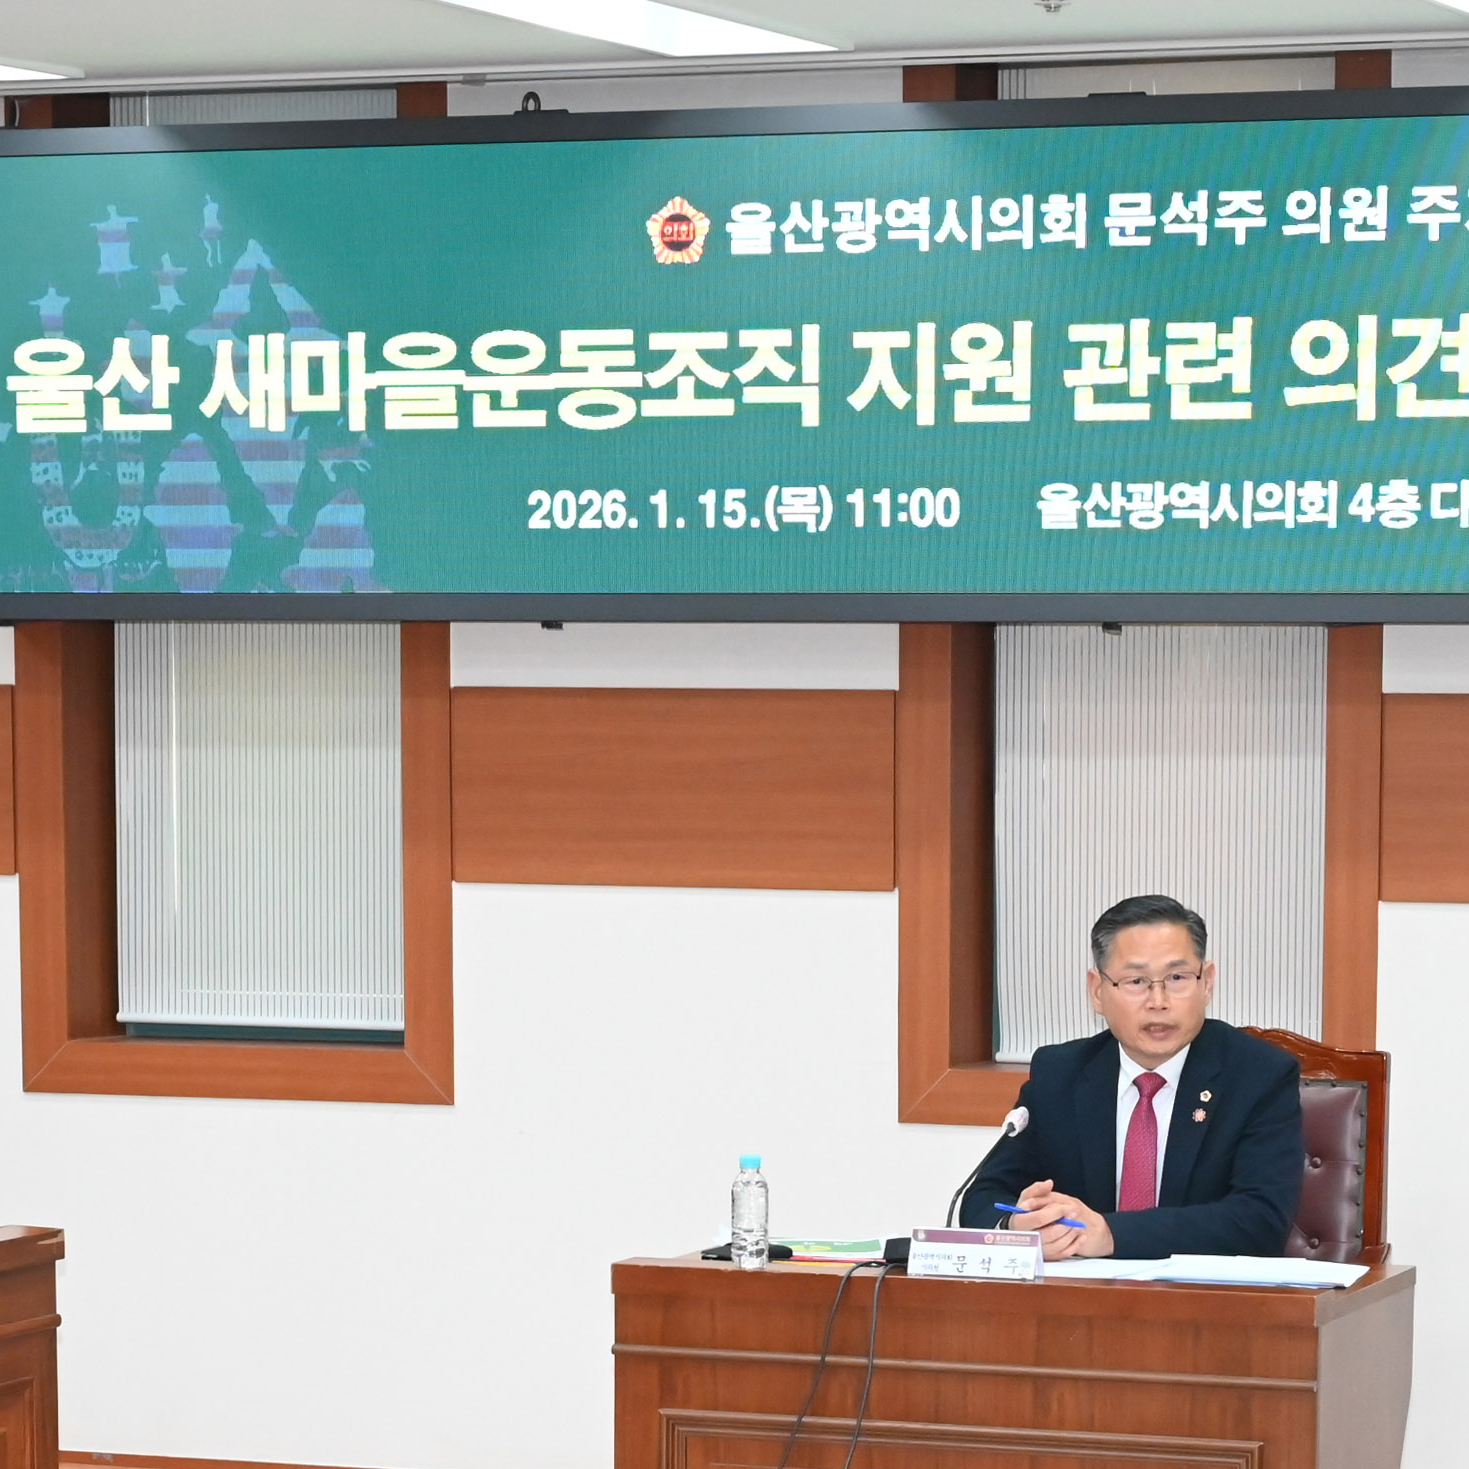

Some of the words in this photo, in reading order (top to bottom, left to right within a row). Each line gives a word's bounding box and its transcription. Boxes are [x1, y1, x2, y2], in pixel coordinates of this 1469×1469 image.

[725, 192, 1088, 254] 울산광역시의회
[1104, 189, 1267, 246] 문석주
[1282, 185, 1388, 244] 의원
[5, 333, 180, 433] 울산
[198, 322, 821, 432] 새마을운동조직
[846, 319, 1033, 427] 지원
[1062, 315, 1254, 422] 관련
[528, 489, 639, 529] 2026.
[650, 489, 685, 529] 1.
[698, 484, 834, 533] 15.(목)
[846, 487, 961, 528] 11:00
[1037, 479, 1339, 530] 울산광역시의회
[1348, 479, 1421, 529] 4층
